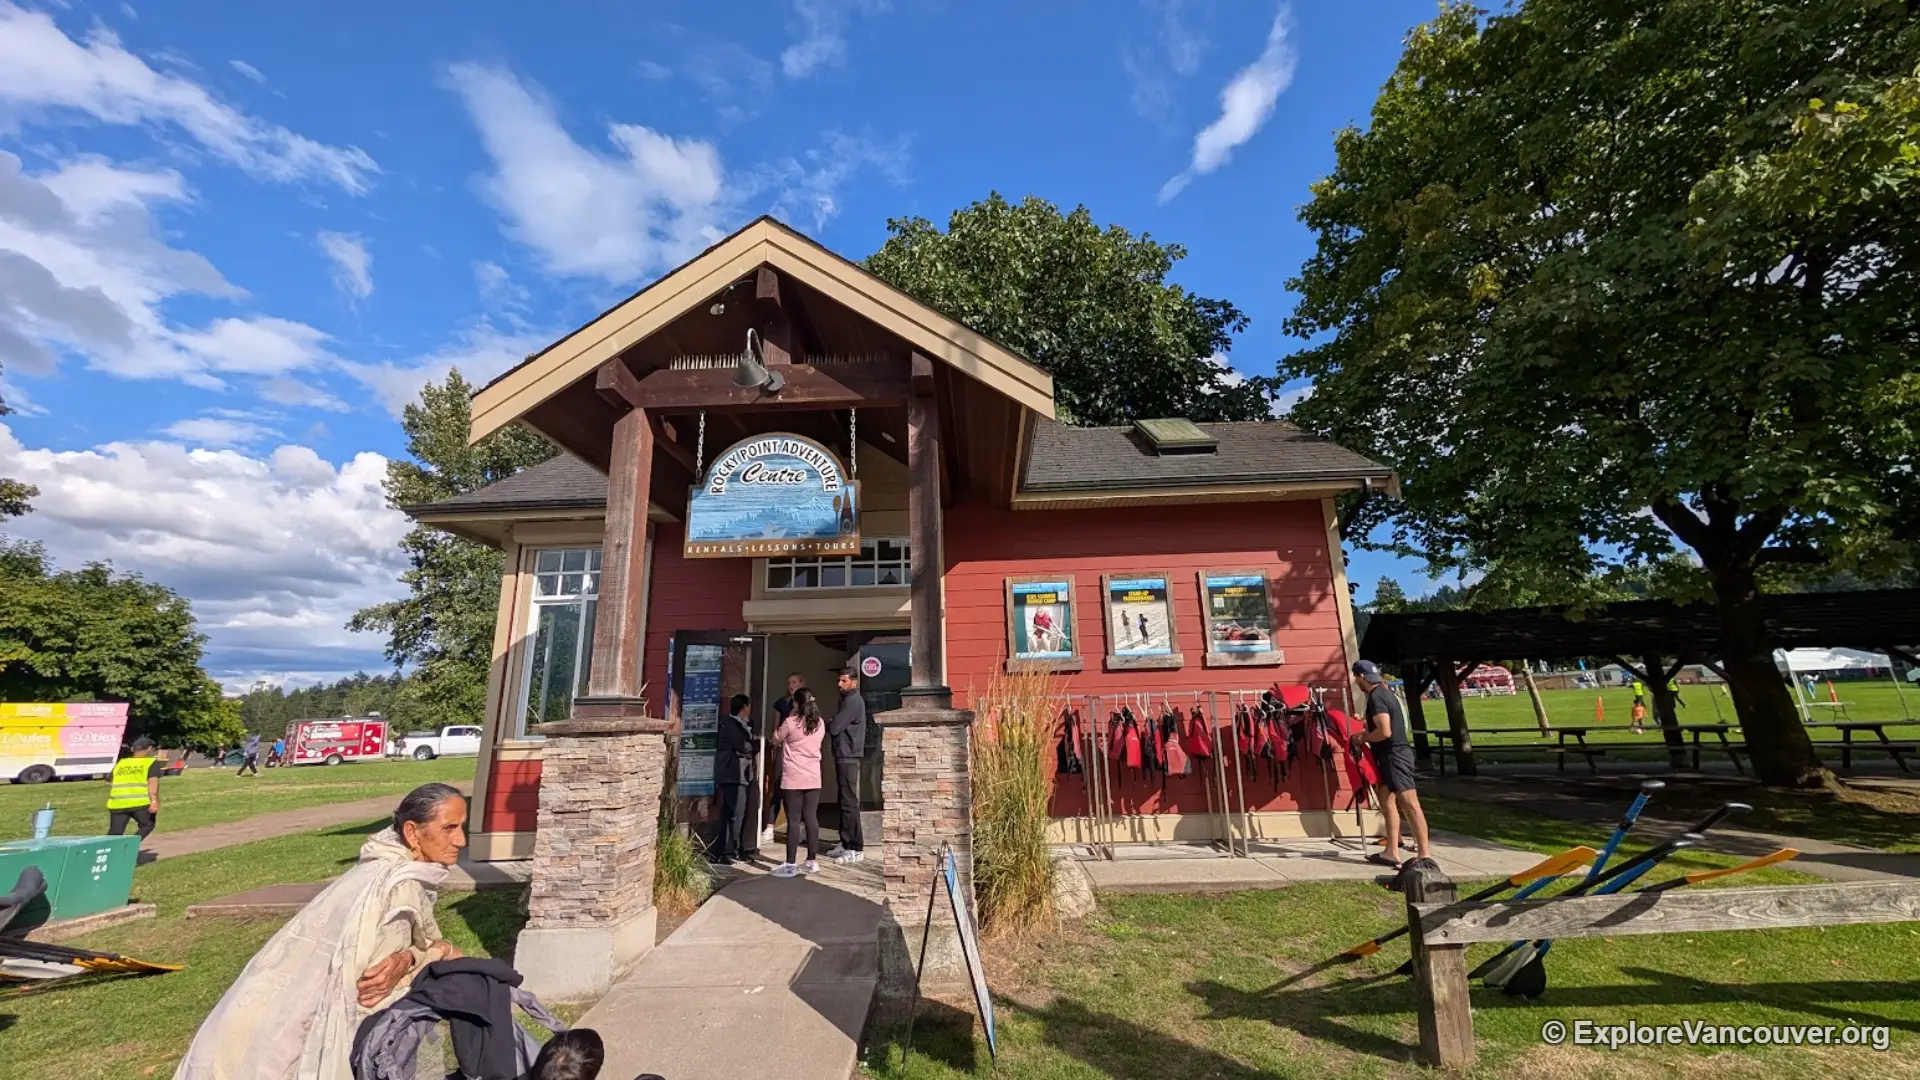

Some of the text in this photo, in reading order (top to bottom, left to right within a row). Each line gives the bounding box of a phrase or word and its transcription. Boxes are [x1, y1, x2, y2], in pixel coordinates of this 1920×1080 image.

[712, 441, 838, 494] ROCKY POINT ADVENTURE
[742, 463, 805, 483] Centre
[688, 541, 855, 554] RENTALS LESSONS TOURS
